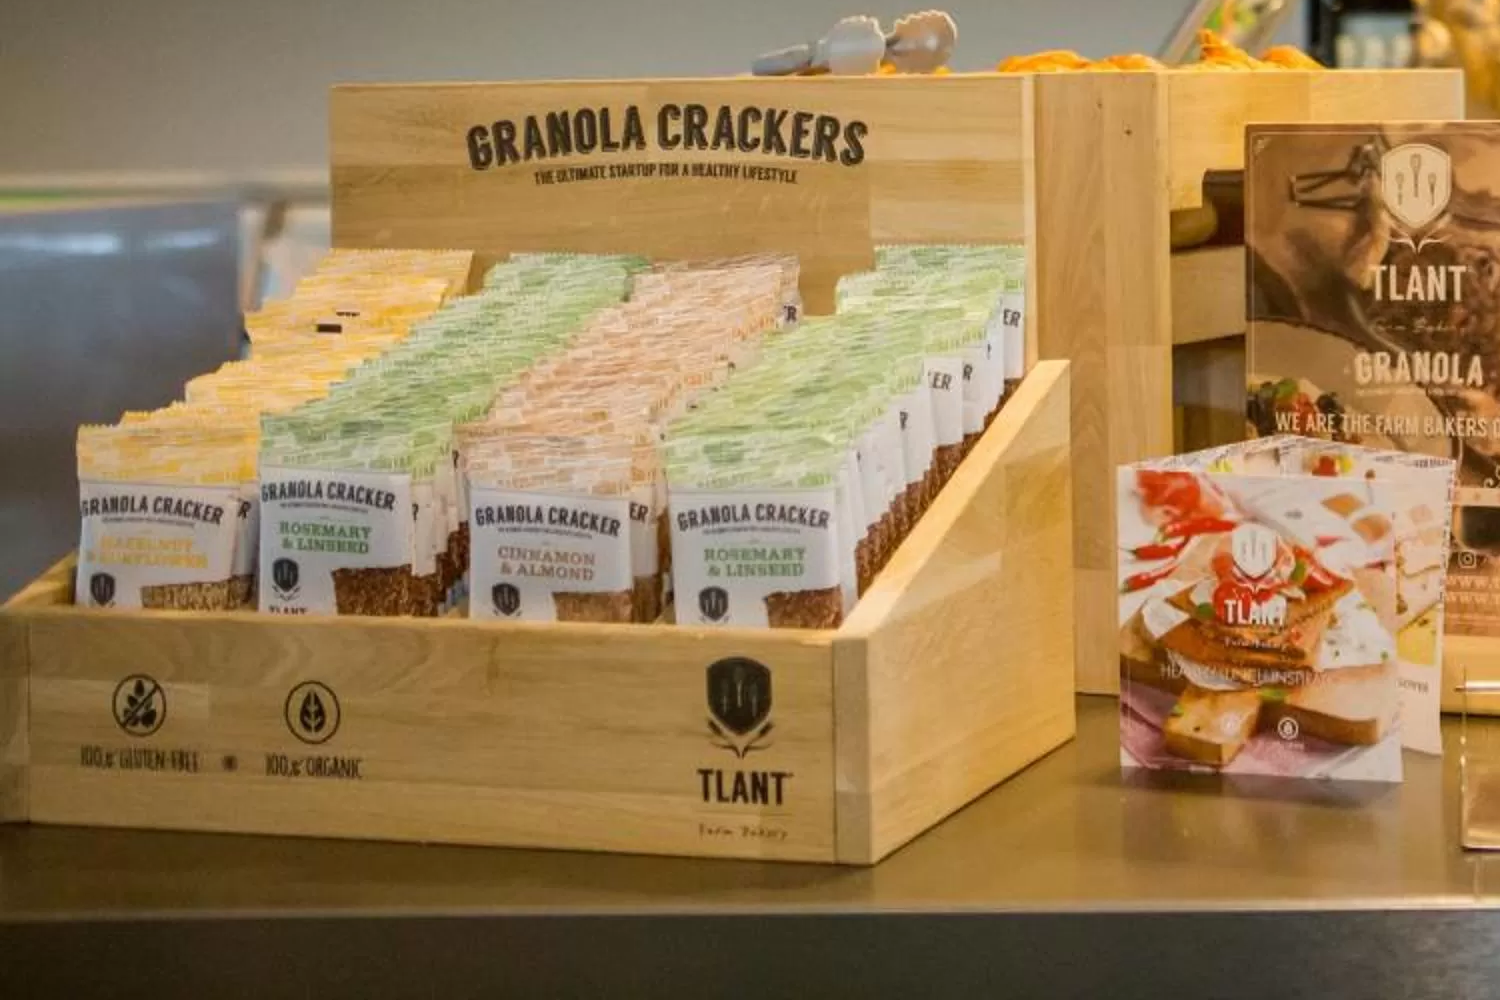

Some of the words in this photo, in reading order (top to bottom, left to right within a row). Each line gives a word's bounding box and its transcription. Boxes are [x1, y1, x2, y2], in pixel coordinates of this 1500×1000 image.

[466, 105, 647, 171] GRANOLA
[657, 104, 868, 166] CRACKERS
[609, 164, 656, 178] STARTUP
[659, 163, 679, 177] FOR
[682, 163, 690, 177] A
[692, 163, 740, 179] HEALTHY
[1369, 265, 1468, 302] TLANT
[1354, 350, 1484, 386] GRANOLA
[1275, 411, 1300, 431] WE
[1305, 413, 1336, 433] ARE
[1342, 413, 1371, 434] THE
[1376, 415, 1419, 437] FARM
[1424, 416, 1487, 438] BAKERS
[261, 480, 323, 503] GRANOLA
[327, 481, 396, 511] CRACKER
[81, 495, 148, 518] GRANOLA
[153, 496, 224, 525] CRACKER
[475, 504, 543, 527] GRANOLA
[548, 505, 621, 537] CRACKER
[677, 503, 751, 532] GRANOLA
[755, 503, 830, 529] CRACKER
[279, 520, 372, 539] ROSEMARY
[297, 538, 369, 555] LINSEED
[497, 546, 595, 565] CINNAMON
[703, 547, 806, 562] ROSEMARY
[517, 563, 594, 581] ALMOND
[727, 563, 804, 577] LINSEED
[1224, 599, 1288, 626] TLANT
[304, 754, 363, 780] ORGANIC
[697, 768, 788, 807] TLANT
